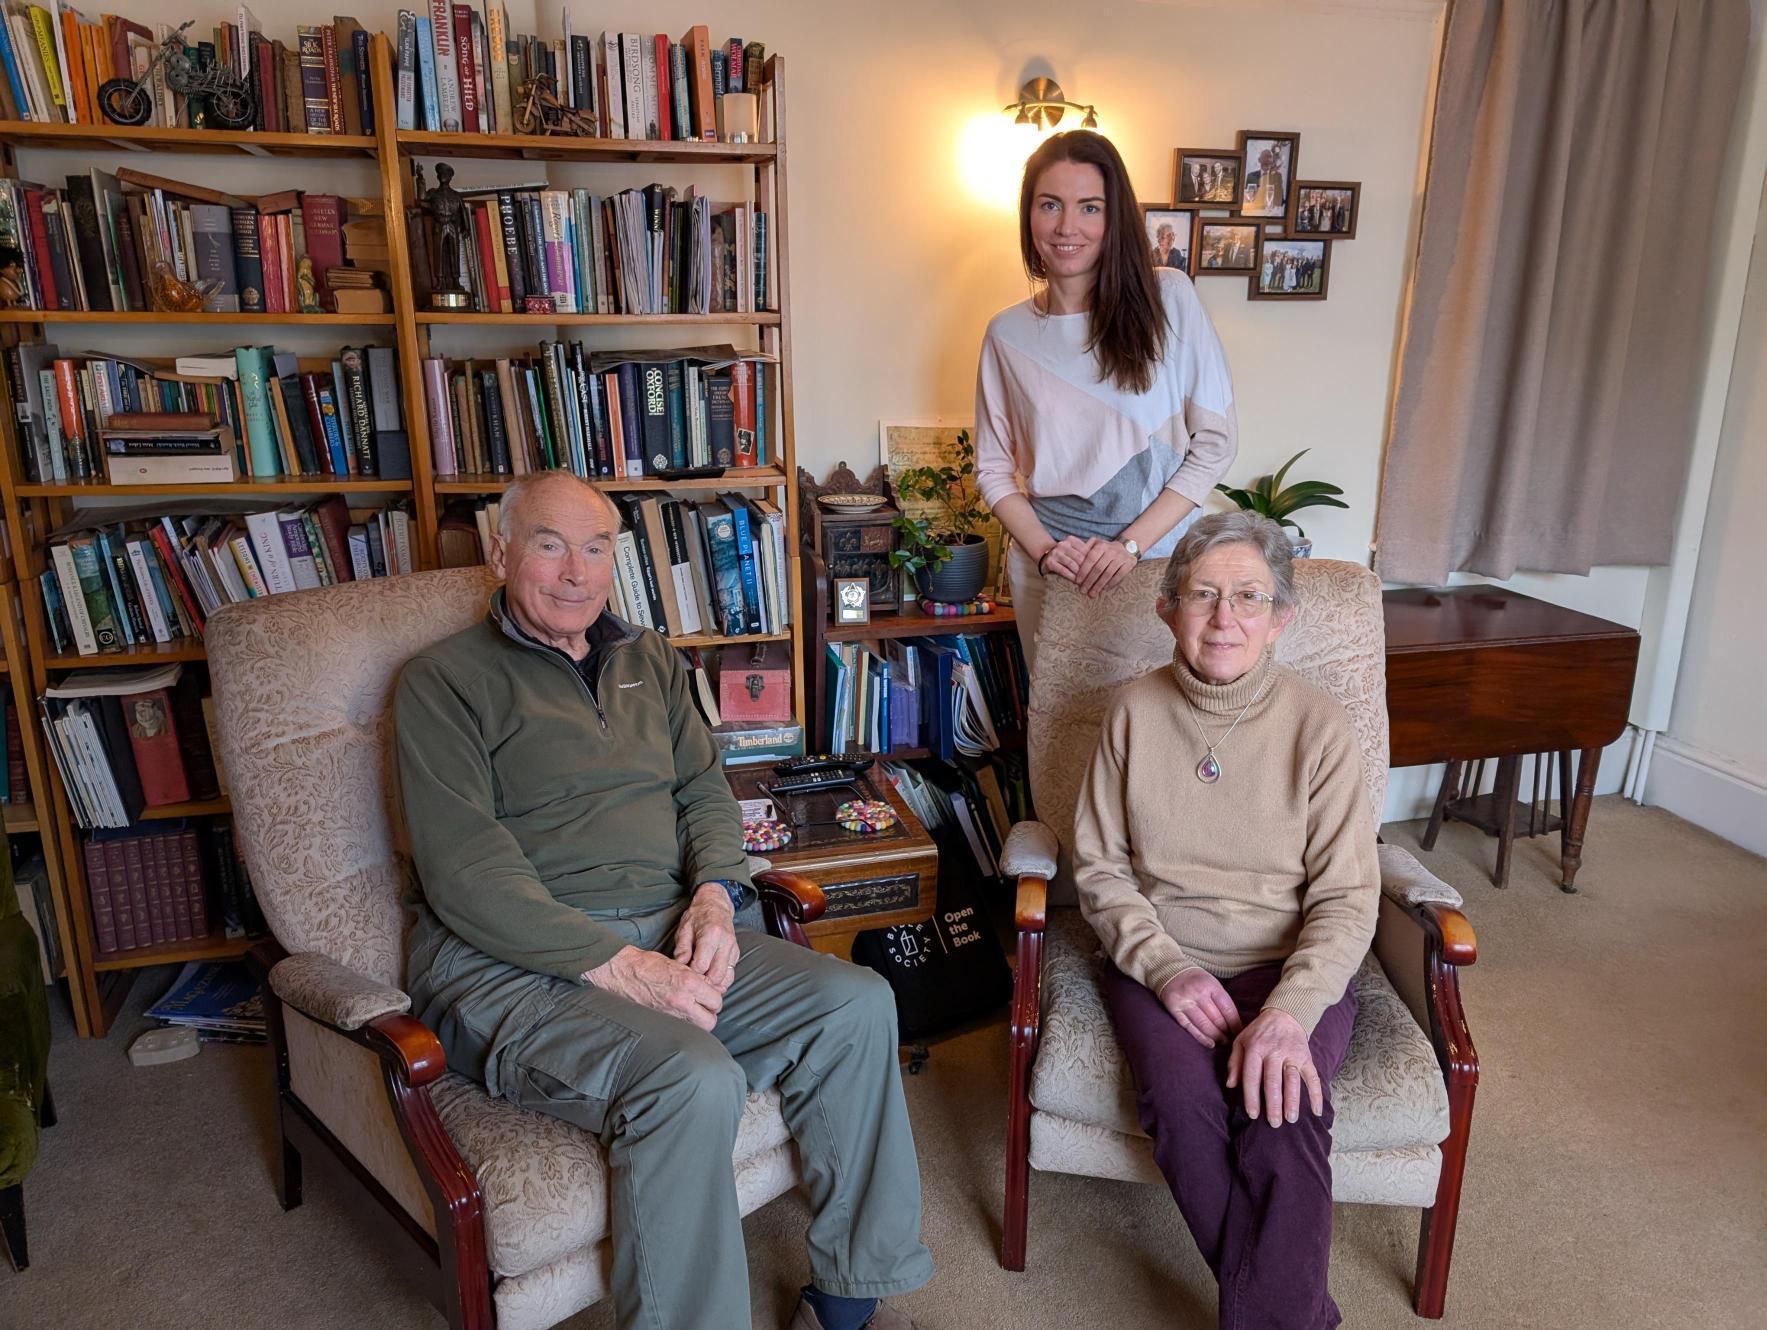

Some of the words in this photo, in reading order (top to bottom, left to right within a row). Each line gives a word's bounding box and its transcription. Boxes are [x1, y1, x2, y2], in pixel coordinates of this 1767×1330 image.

[630, 38, 642, 93] BIRDSONG
[730, 42, 738, 78] WOLMAR
[440, 77, 450, 113] LAMBERT
[448, 79, 457, 114] ANDREW
[463, 78, 474, 111] HILD
[500, 195, 518, 255] PHOEBE
[548, 212, 562, 242] Roget's
[352, 375, 365, 416] RICHARD
[646, 371, 656, 413] OXFORD
[654, 370, 664, 413] CONCISE
[358, 418, 370, 460] DANNATT
[738, 520, 748, 540] BLUE
[743, 545, 752, 576] PLANET
[624, 546, 636, 579] Complete
[631, 580, 641, 602] Guide
[636, 602, 642, 610] to
[738, 734, 782, 747] Timberland
[944, 906, 974, 922] Open
[948, 922, 968, 936] the
[888, 937, 931, 968] SOCIETY
[952, 930, 981, 948] Book
